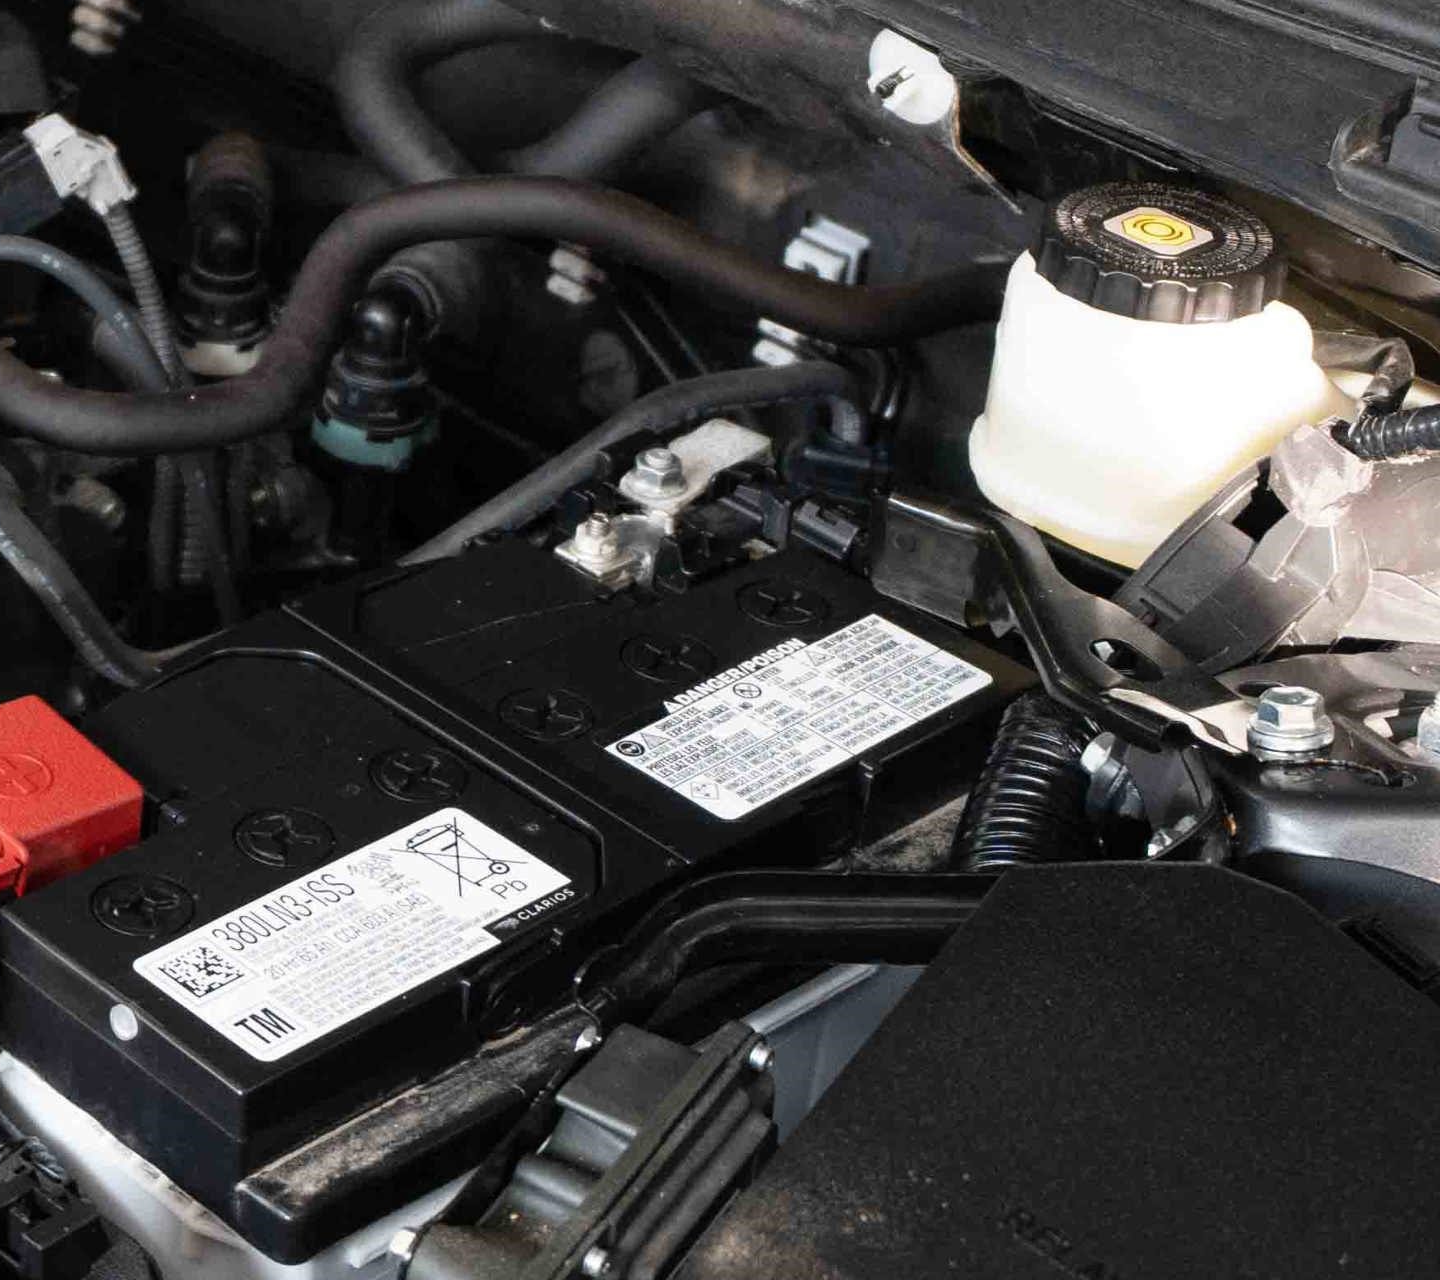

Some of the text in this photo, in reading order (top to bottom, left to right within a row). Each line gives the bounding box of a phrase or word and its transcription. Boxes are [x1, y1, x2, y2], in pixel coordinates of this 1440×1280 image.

[677, 637, 807, 703] DANGER/POISON
[489, 877, 528, 901] Pb
[516, 887, 576, 922] CLARIOS
[211, 870, 356, 953] 380LN3-ISS
[232, 1006, 297, 1046] TM
